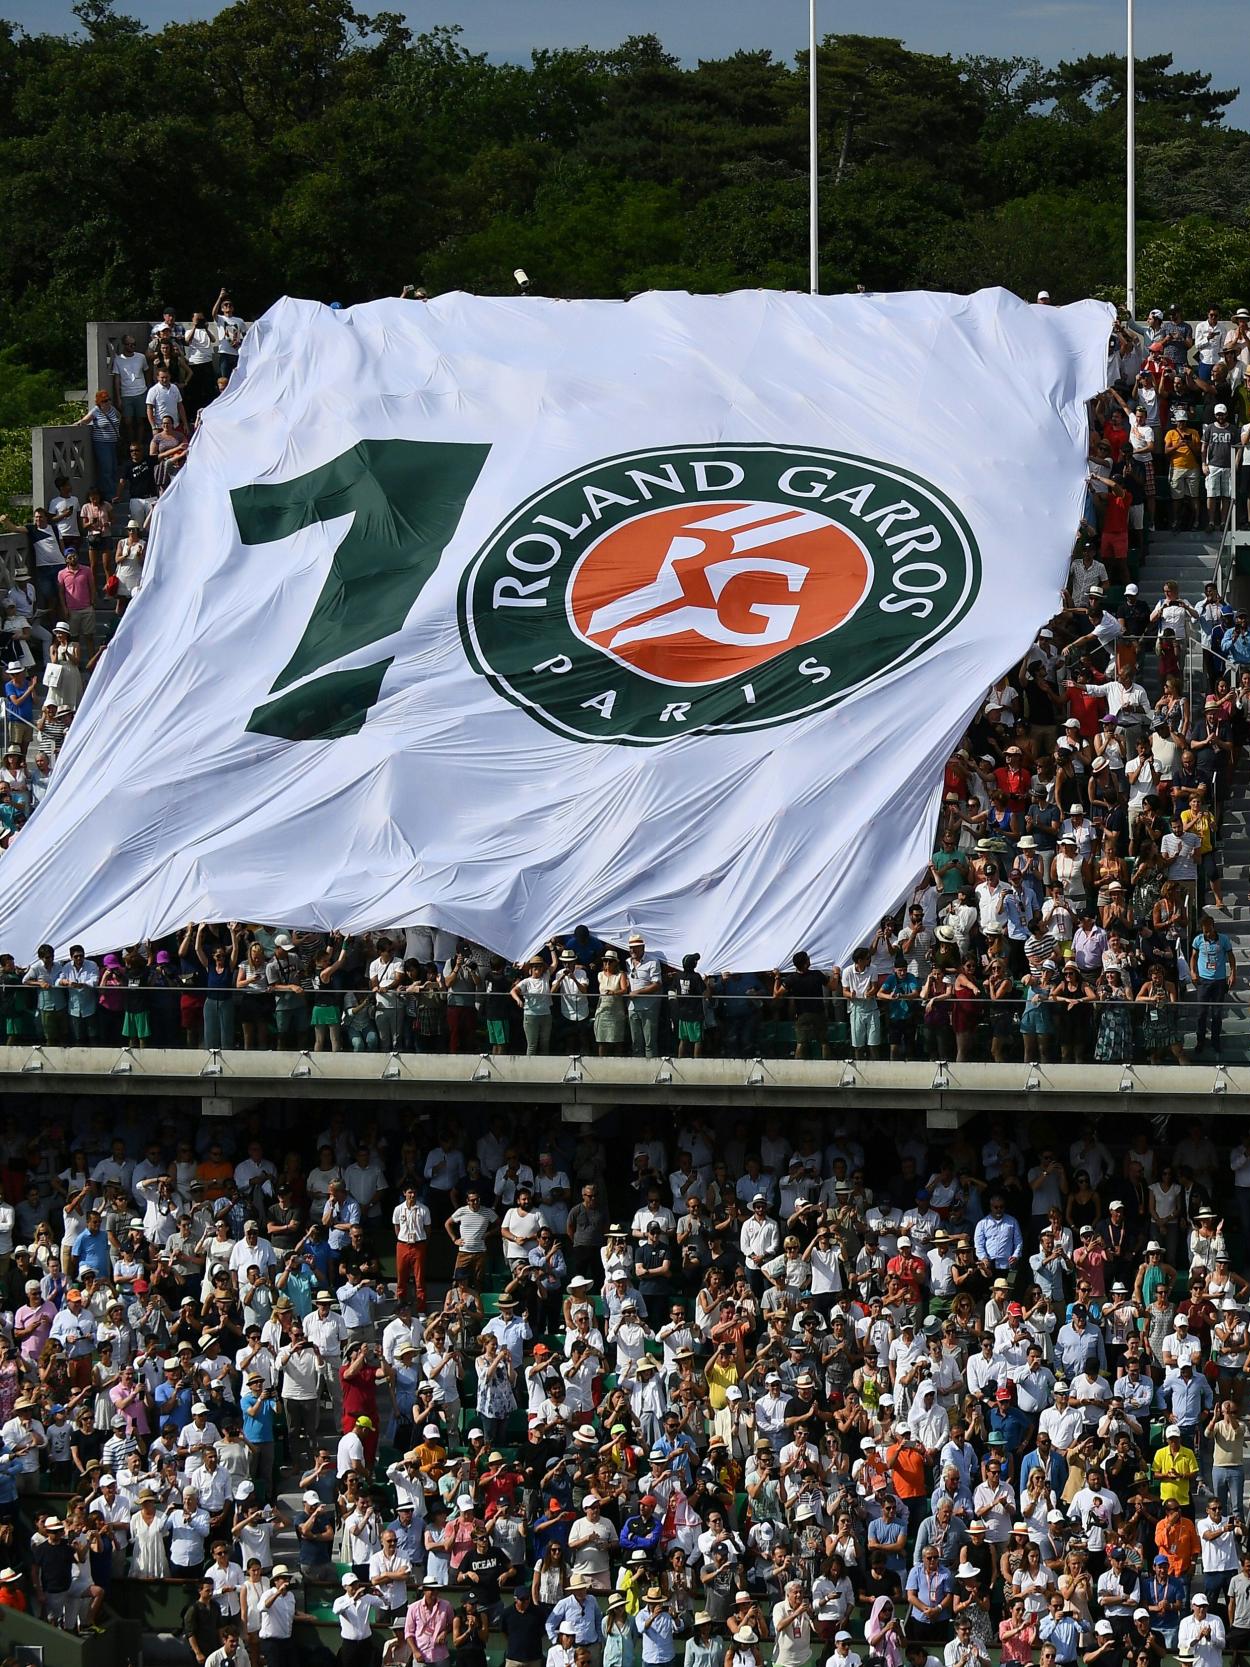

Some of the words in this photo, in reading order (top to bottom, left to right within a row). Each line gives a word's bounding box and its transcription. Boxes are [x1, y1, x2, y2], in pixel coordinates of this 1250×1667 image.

[493, 460, 745, 609] ROLAND
[777, 465, 948, 620] GARROS
[532, 653, 832, 723] PARIS
[471, 1557, 497, 1571] OCEAN
